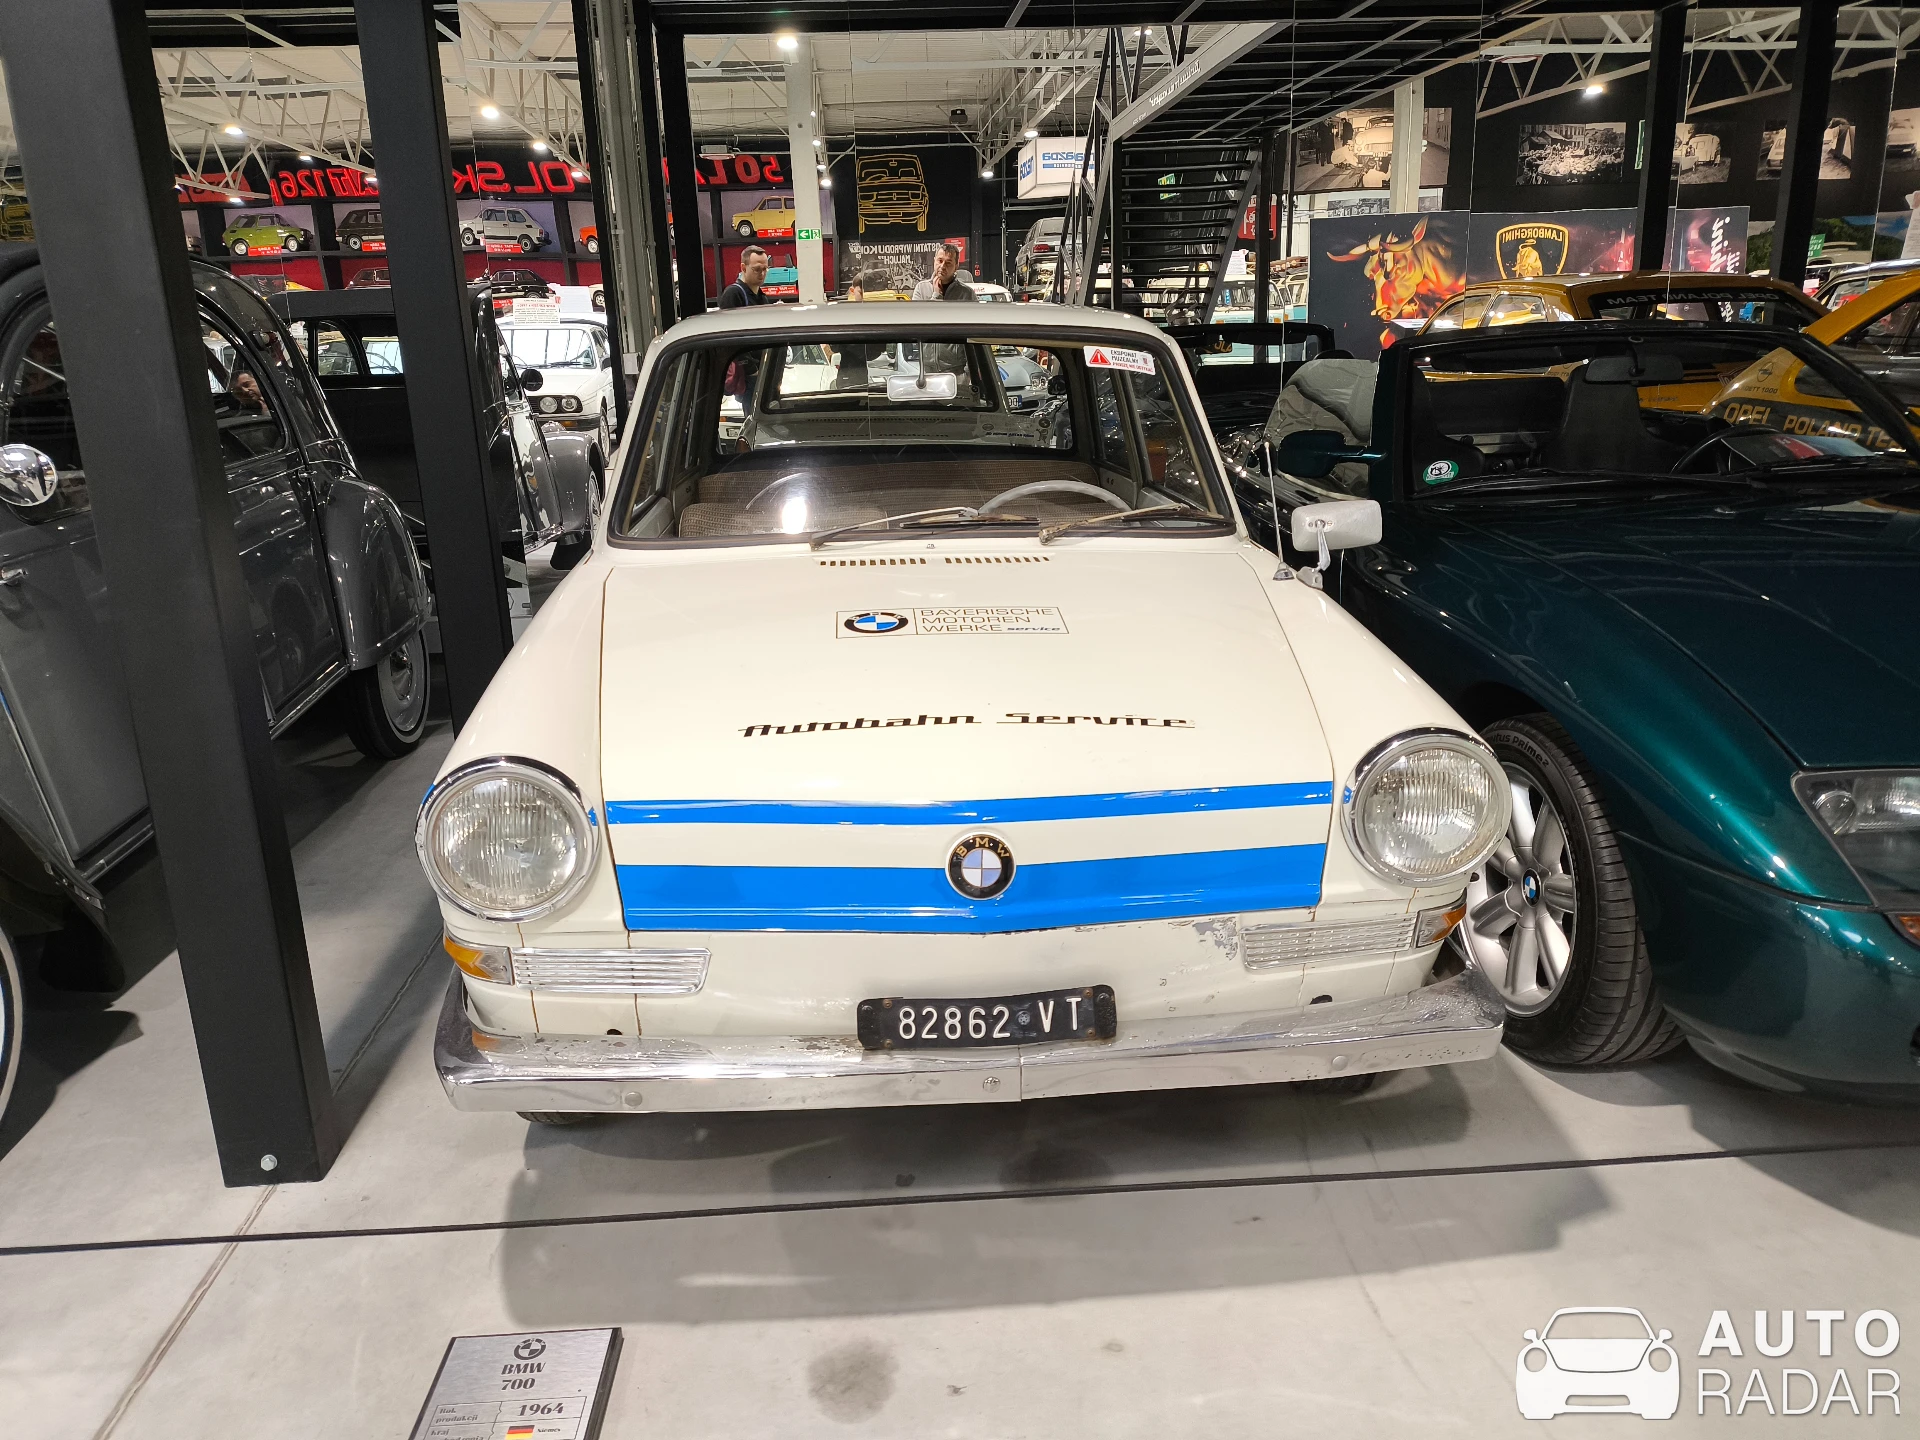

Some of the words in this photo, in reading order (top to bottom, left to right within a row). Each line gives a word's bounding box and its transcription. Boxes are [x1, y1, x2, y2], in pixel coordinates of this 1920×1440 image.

[1110, 350, 1137, 358] EKSPONAT
[1112, 356, 1139, 364] MUZEALNY
[1783, 415, 1862, 441] POLAND
[920, 608, 1055, 616] BAYERISCHE
[921, 616, 1032, 624] MOTOREN
[922, 624, 1003, 632] WERKE
[738, 714, 981, 738] Autobahn
[996, 712, 1196, 729] Service
[955, 836, 1010, 858] BMW
[899, 1006, 1011, 1040] 82862
[501, 1361, 547, 1375] BMW
[500, 1377, 536, 1391] 700
[518, 1401, 565, 1417] 1964
[435, 1414, 479, 1424] produkcji
